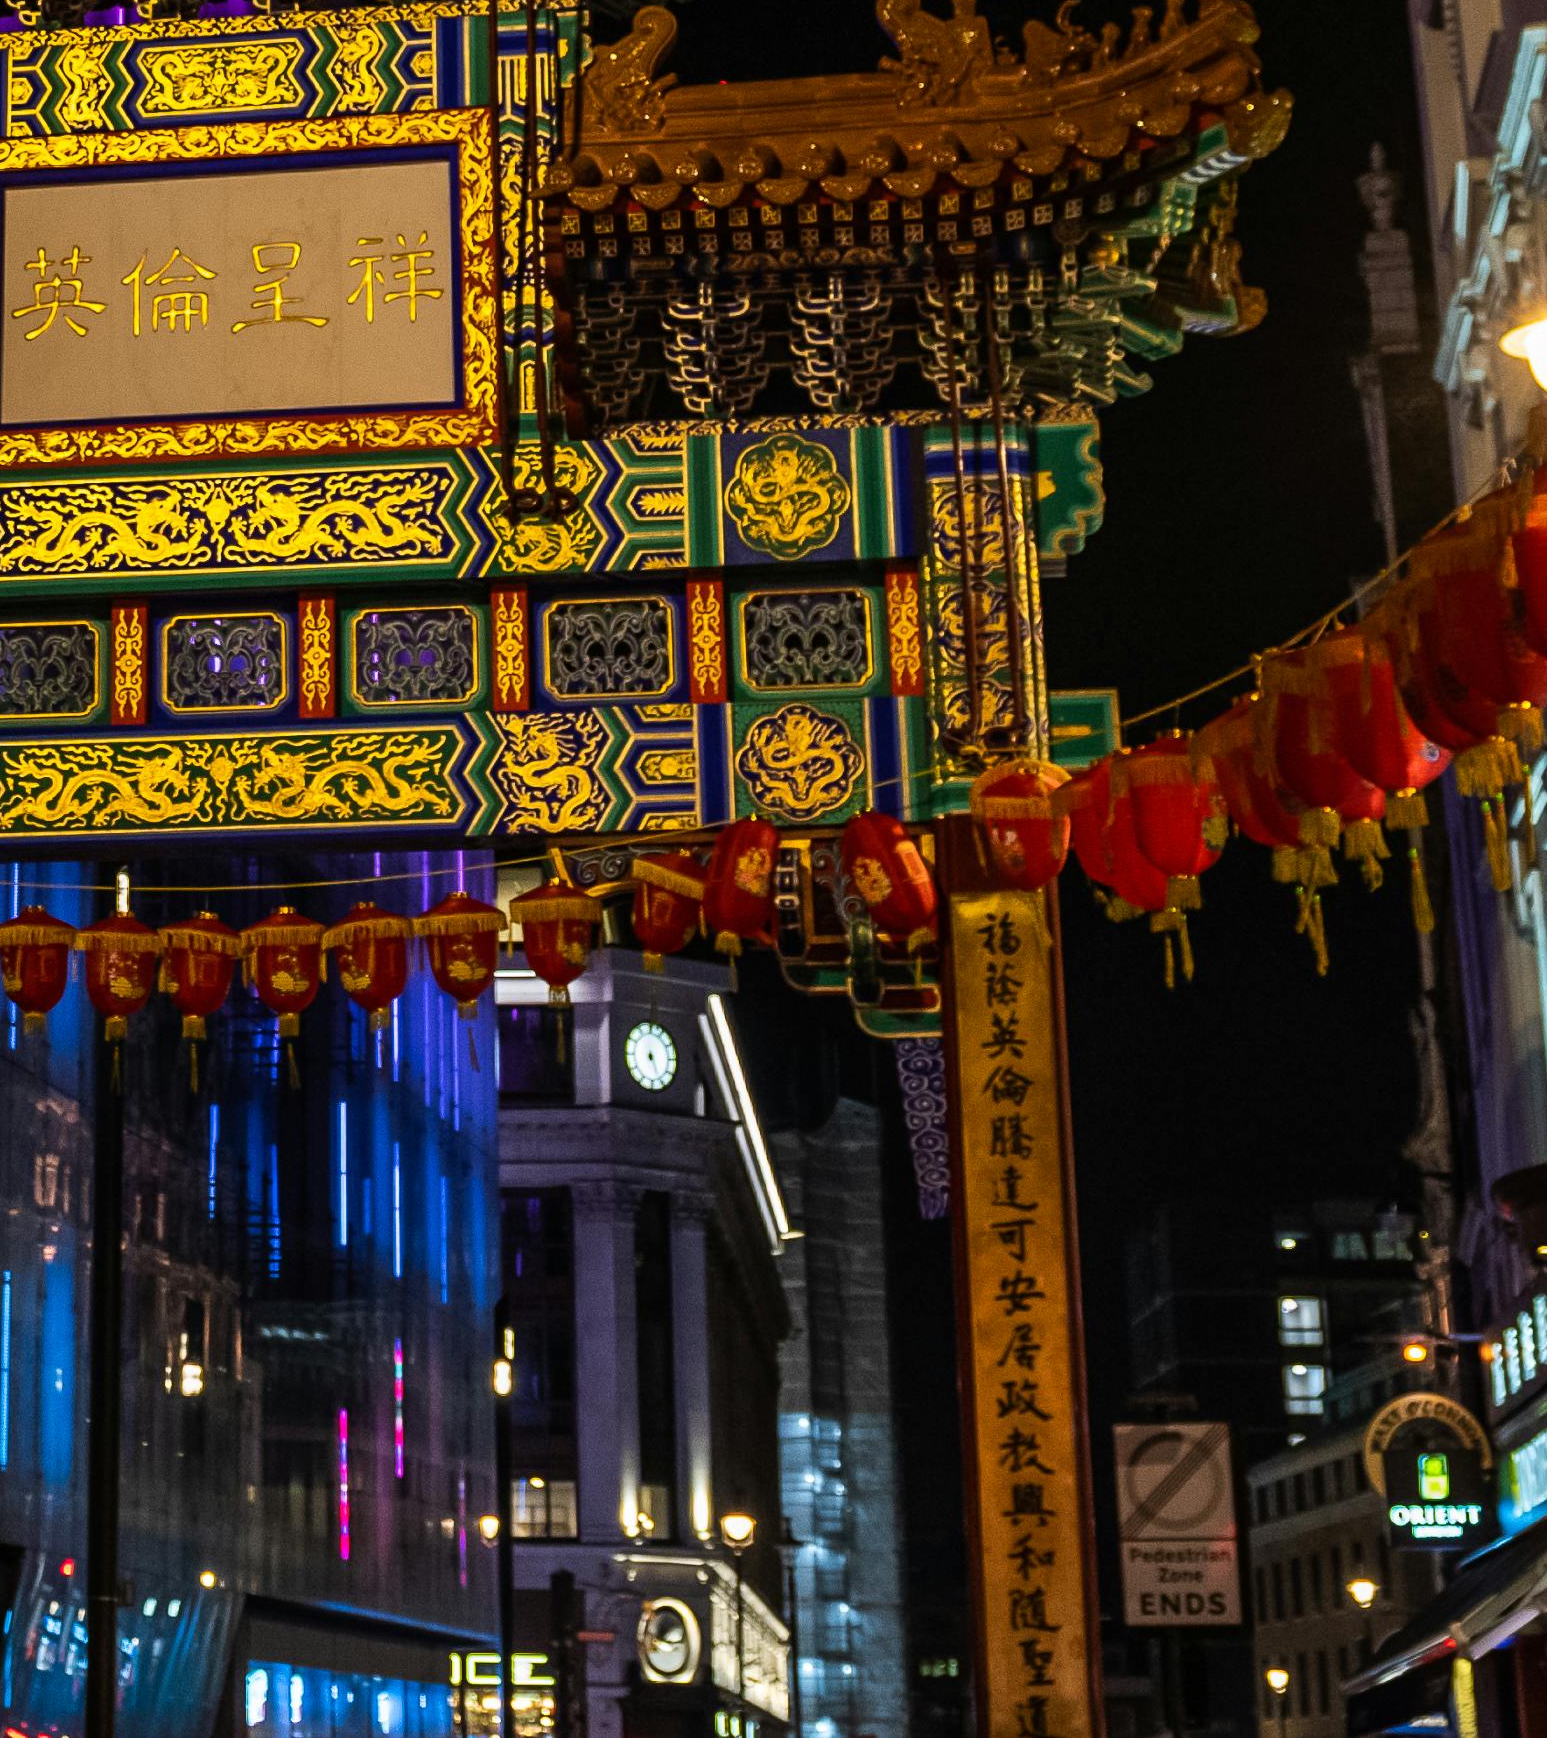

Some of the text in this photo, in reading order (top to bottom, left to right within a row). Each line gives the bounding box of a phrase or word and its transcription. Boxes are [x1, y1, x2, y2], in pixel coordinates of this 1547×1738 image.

[10, 228, 445, 342] 英倫呈祥
[1389, 1504, 1482, 1527] ORIENT
[1129, 1547, 1232, 1563] Pedestrian
[1158, 1566, 1204, 1583] Zone
[1139, 1591, 1227, 1616] ENDS
